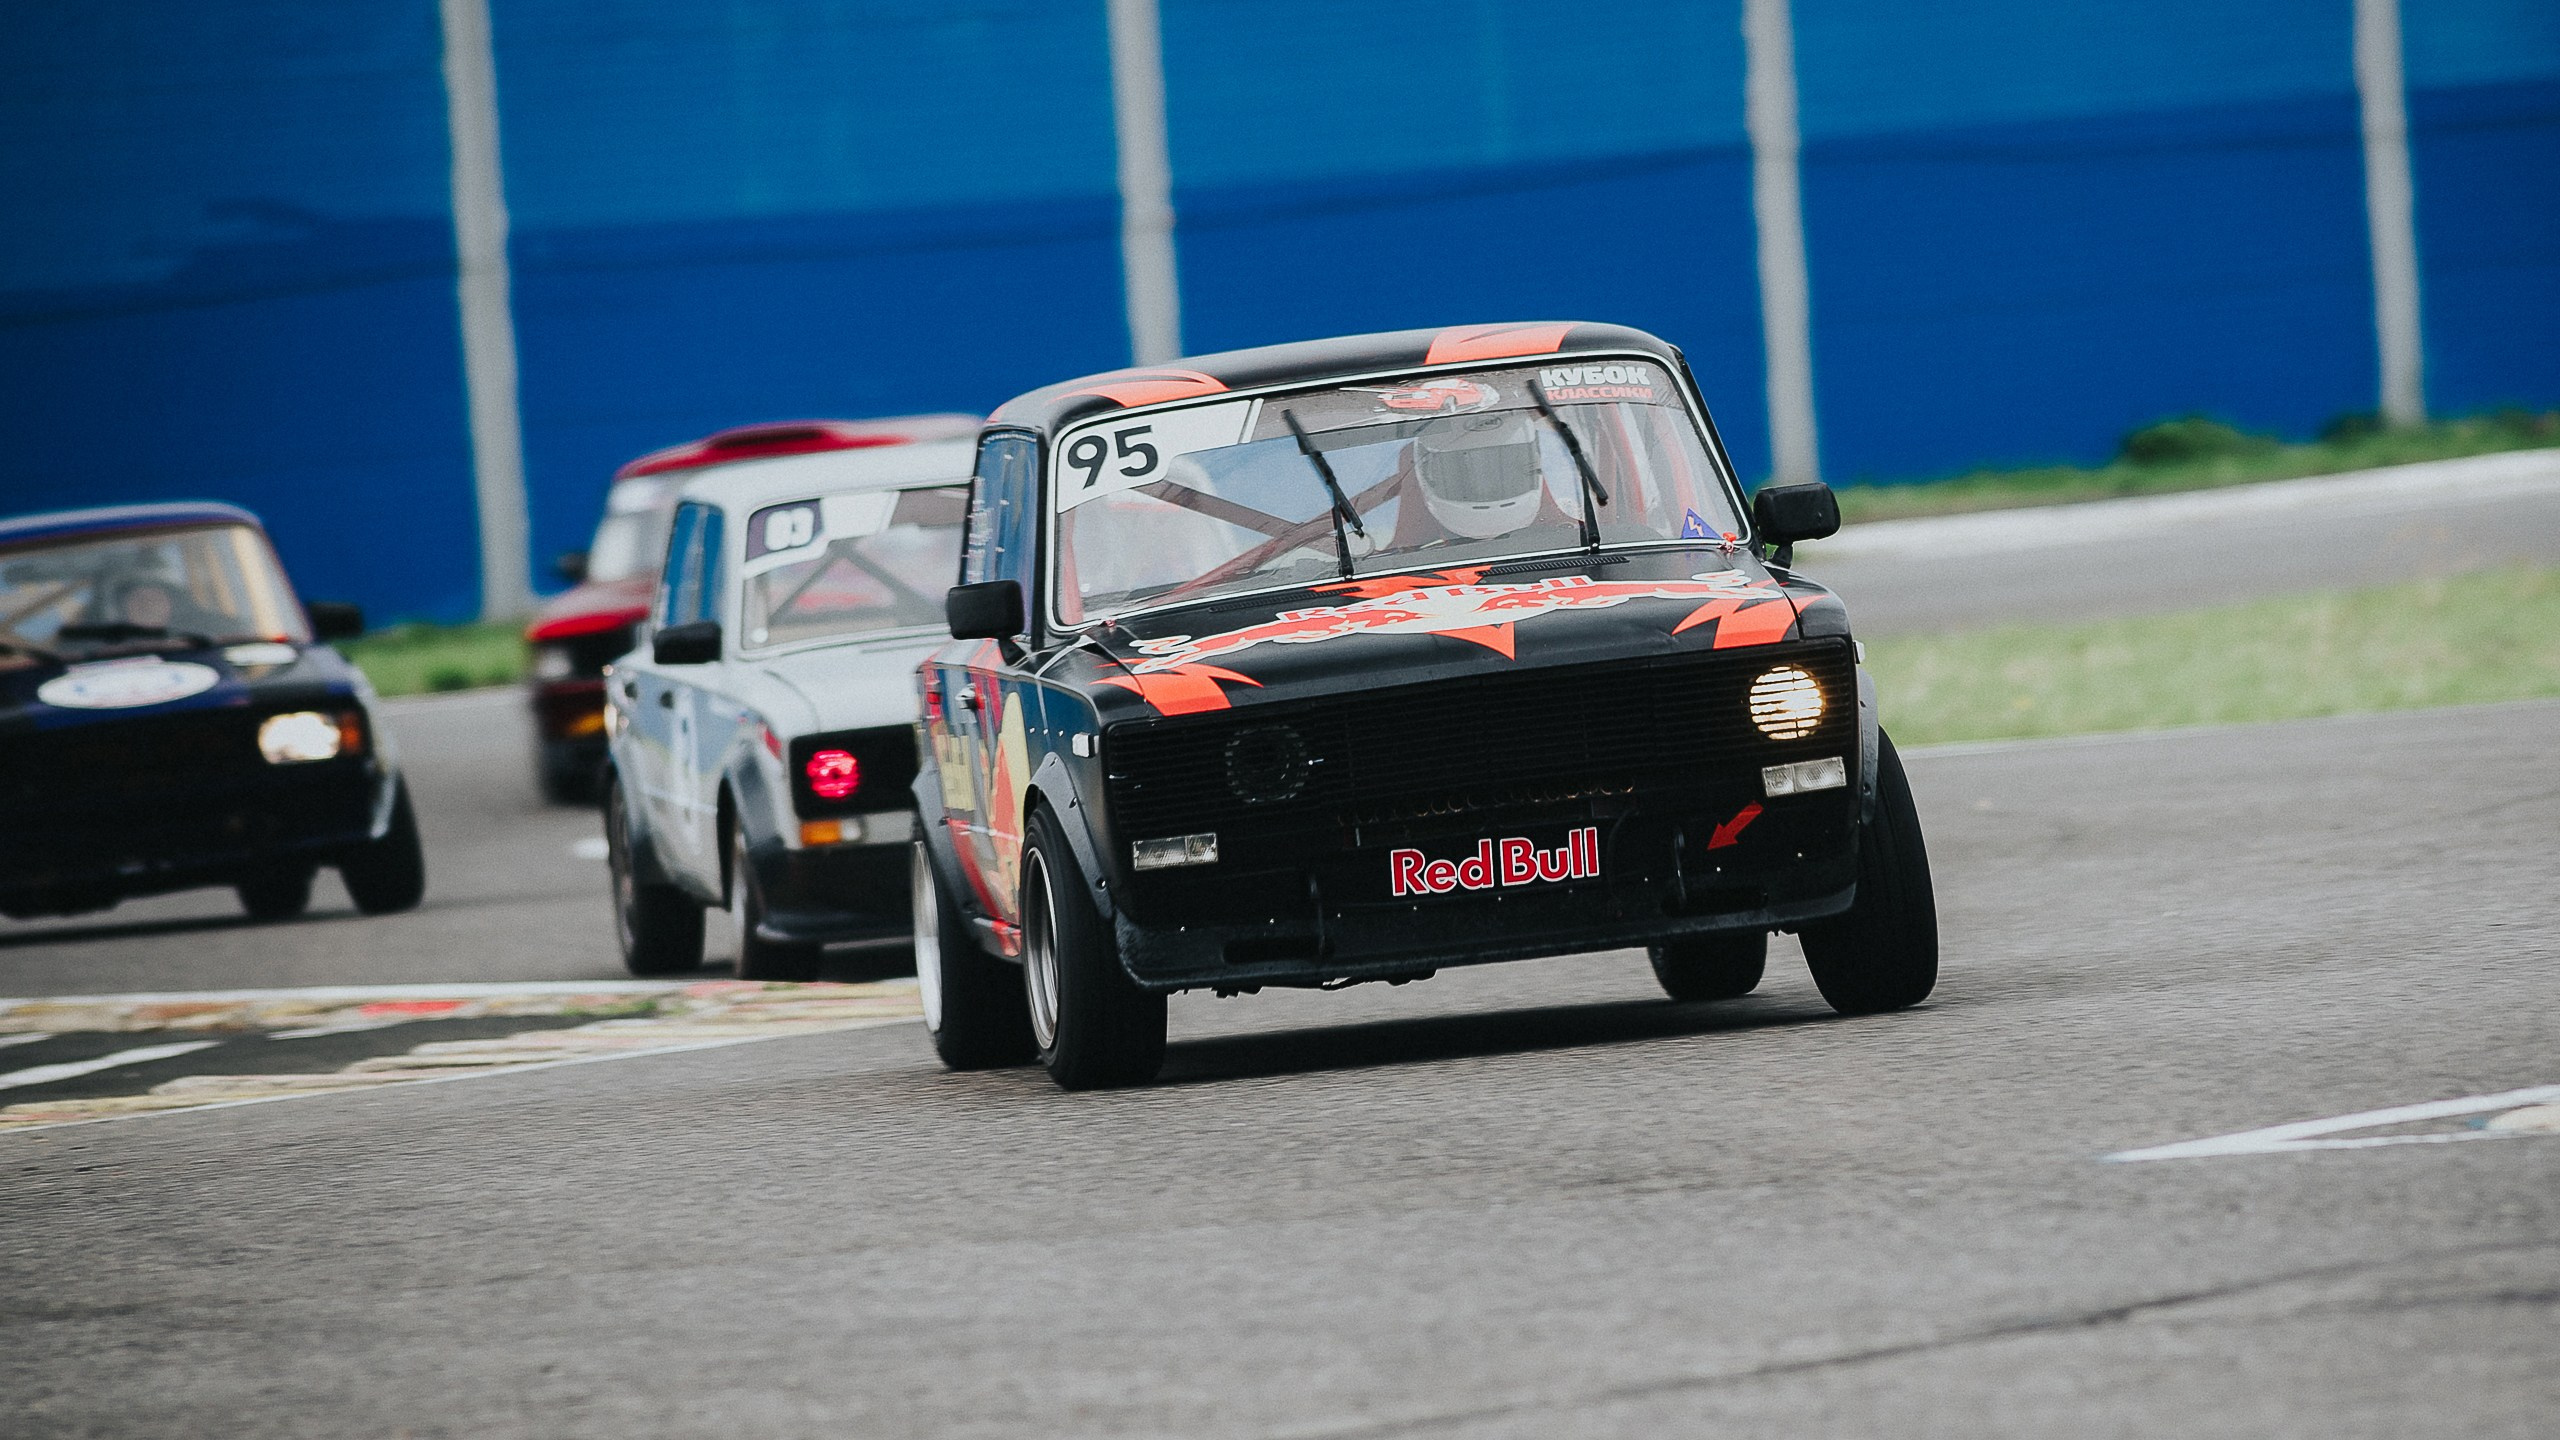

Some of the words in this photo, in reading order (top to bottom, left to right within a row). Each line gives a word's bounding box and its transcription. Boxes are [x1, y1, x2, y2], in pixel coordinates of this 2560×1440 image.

[1539, 365, 1650, 388] КУБОК
[1546, 386, 1653, 401] КЛАССИКИ
[1067, 424, 1158, 490] 95
[1390, 838, 1494, 896] Red
[1500, 826, 1600, 887] Bull
